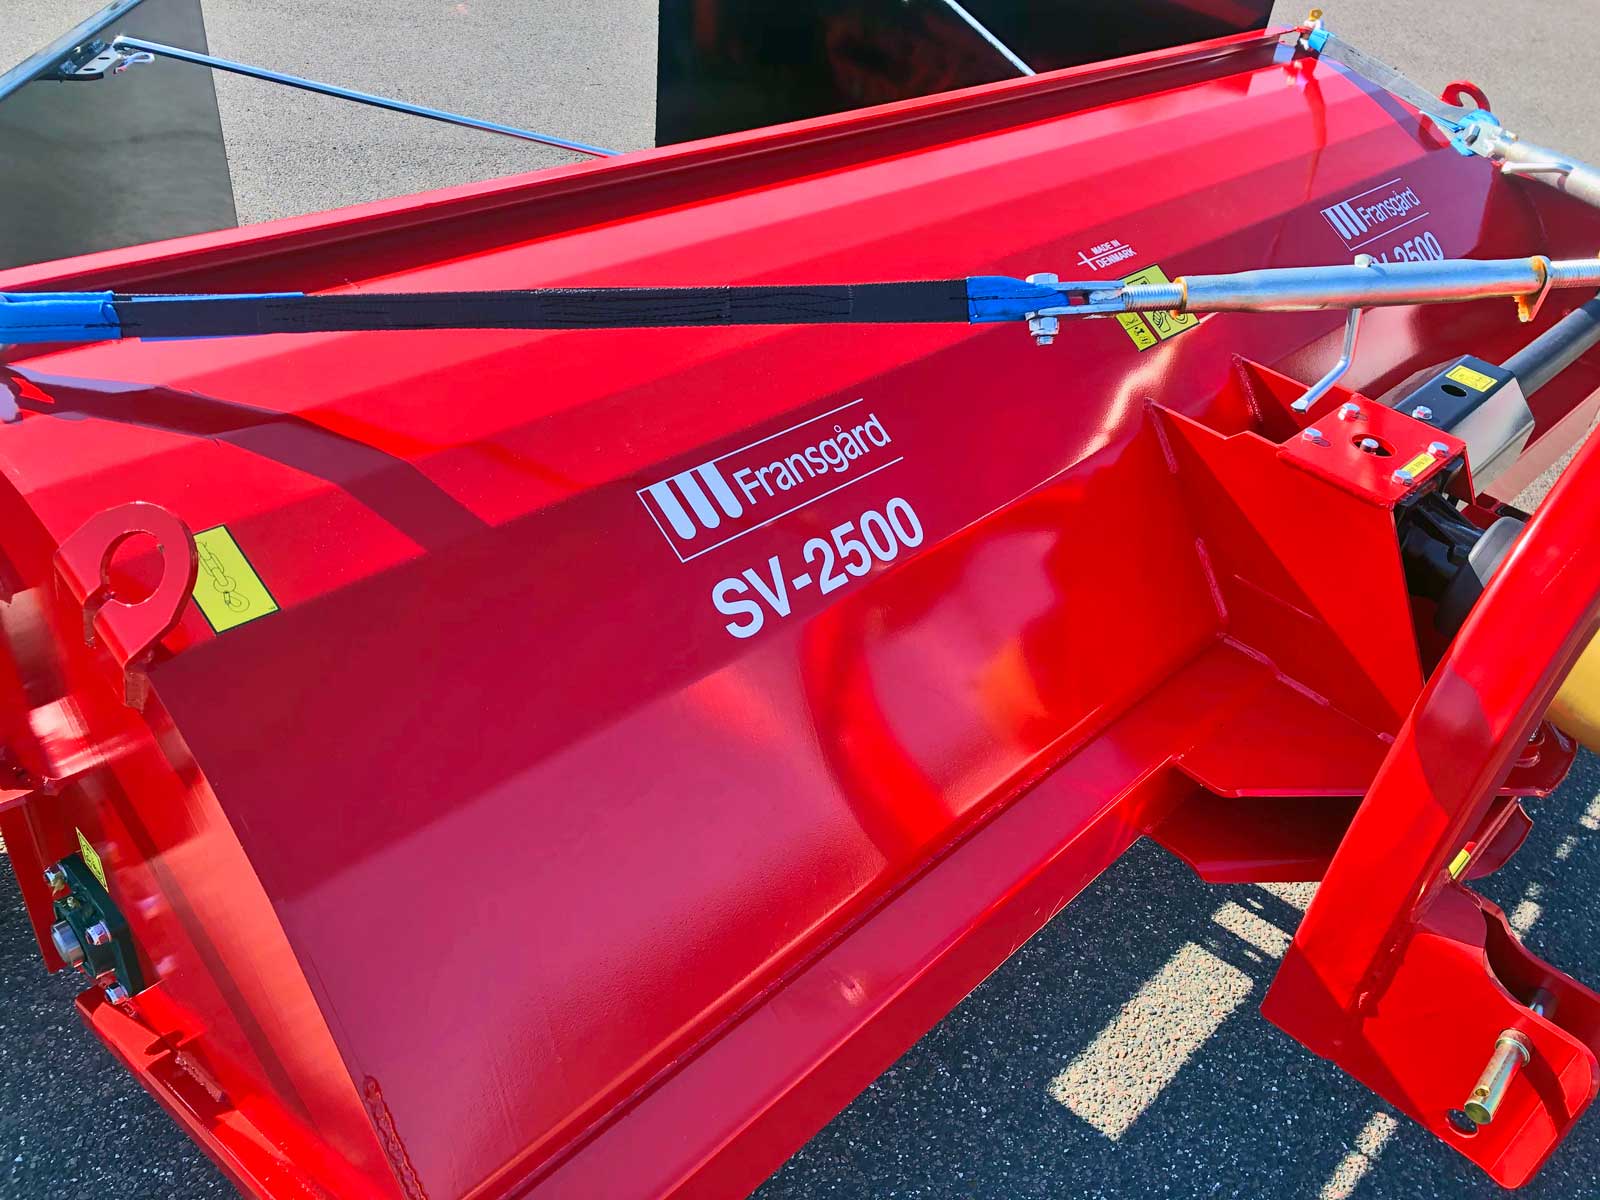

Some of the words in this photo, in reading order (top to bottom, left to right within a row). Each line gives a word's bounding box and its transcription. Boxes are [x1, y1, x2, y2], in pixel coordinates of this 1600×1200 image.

[1357, 186, 1421, 227] Fransgård
[1091, 242, 1114, 255] MADE
[1110, 239, 1121, 248] IN
[1096, 247, 1137, 268] DENMARK
[732, 413, 892, 505] Fransgård
[712, 497, 924, 639] SV-2500
